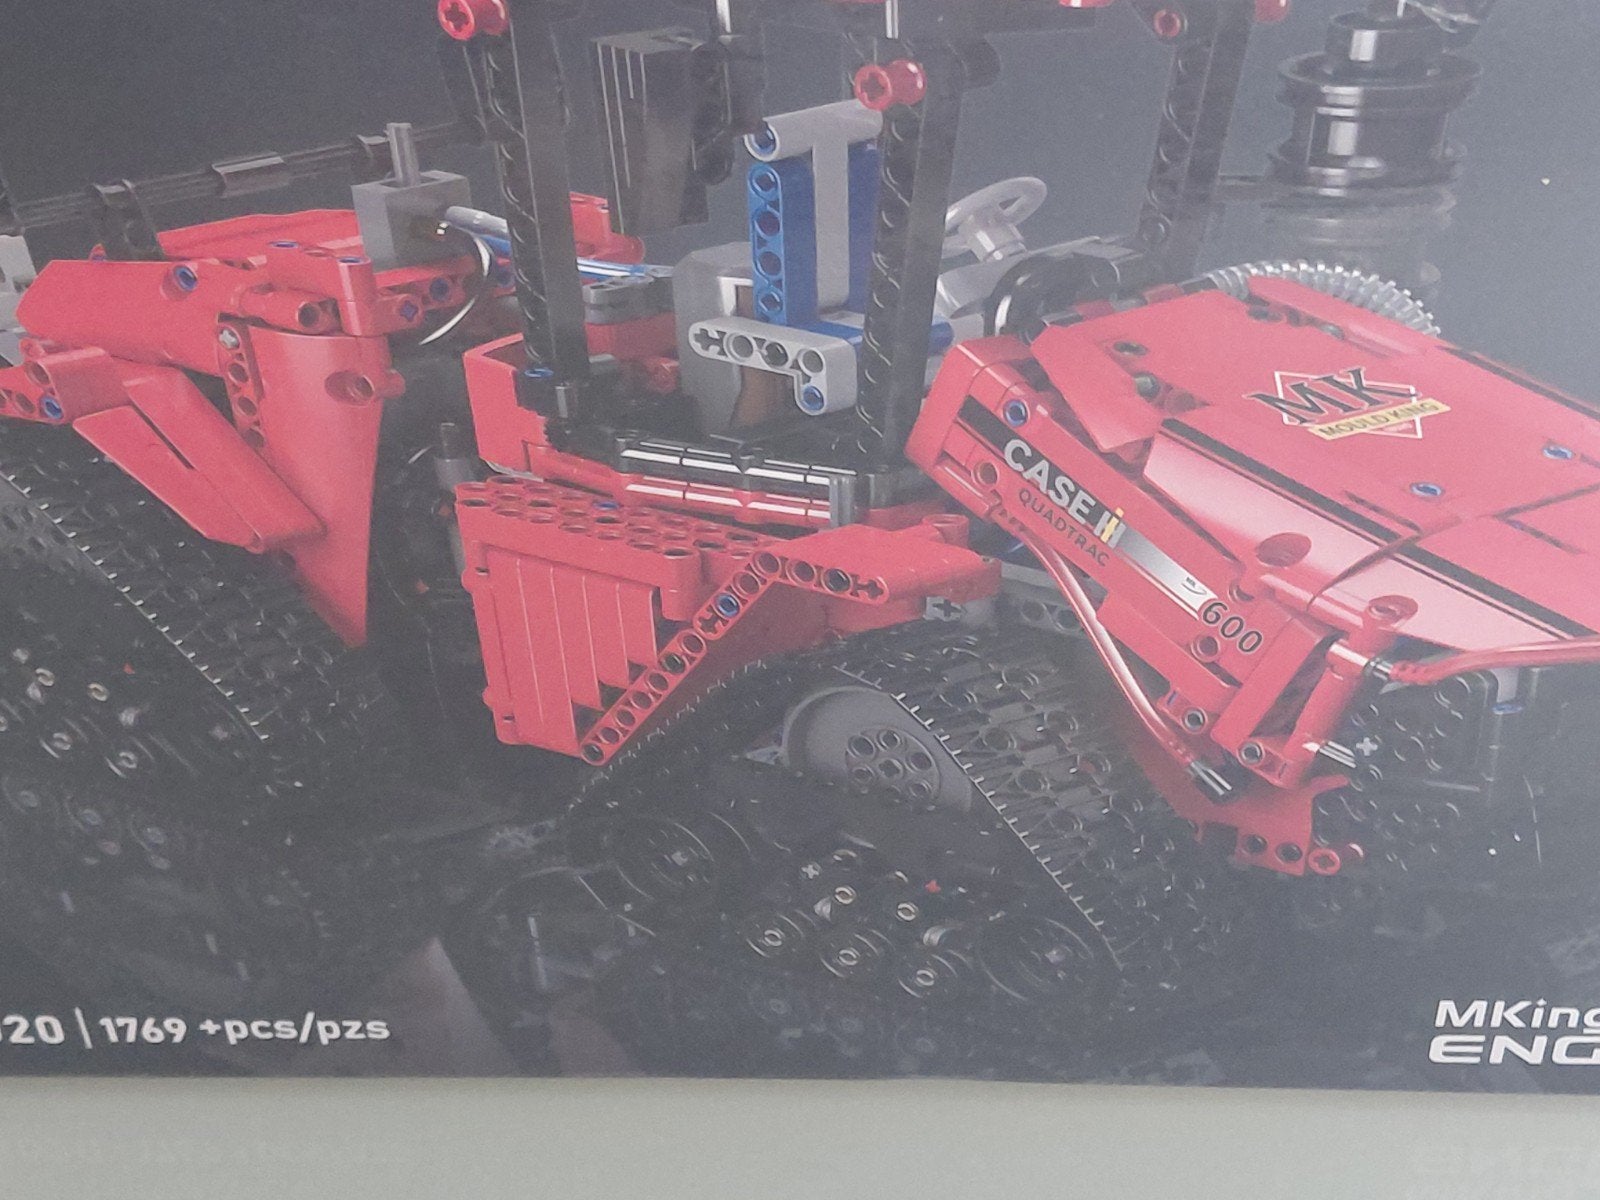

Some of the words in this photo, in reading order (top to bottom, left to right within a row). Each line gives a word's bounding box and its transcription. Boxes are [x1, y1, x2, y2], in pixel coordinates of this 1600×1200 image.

[1243, 368, 1422, 425] MK
[1003, 438, 1097, 525] CASE
[1017, 488, 1111, 568] QUADTRAC
[1201, 600, 1265, 654] 600
[0, 1014, 65, 1044] 20
[99, 1015, 188, 1044] 1769
